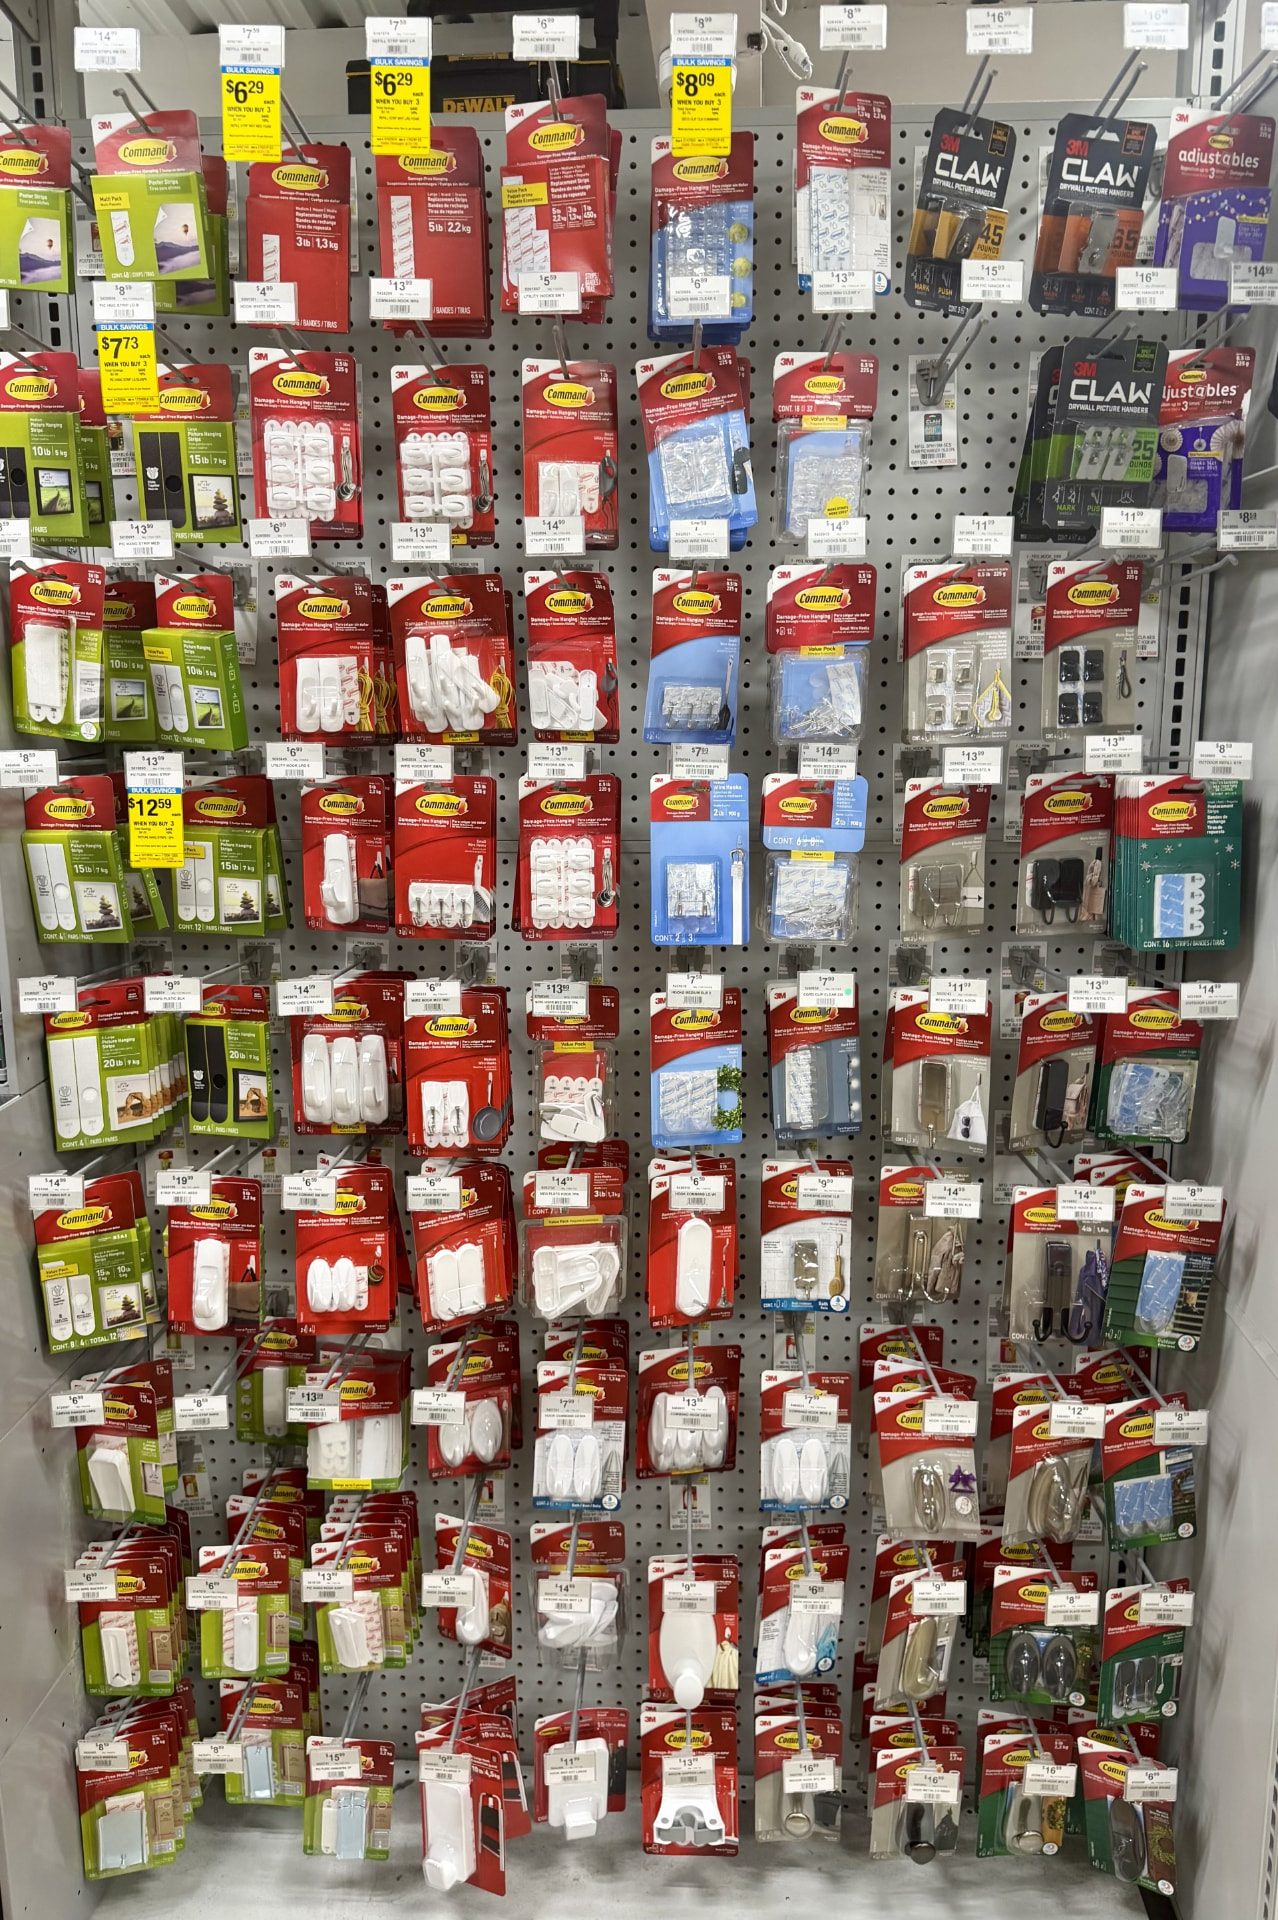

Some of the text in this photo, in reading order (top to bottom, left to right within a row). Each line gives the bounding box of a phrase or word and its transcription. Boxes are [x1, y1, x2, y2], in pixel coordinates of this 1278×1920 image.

[801, 93, 813, 101] 3M
[511, 110, 524, 118] 3M
[1176, 114, 1188, 122] 3M
[98, 122, 112, 130] 3M
[823, 123, 860, 137] Command
[123, 145, 167, 157] Command
[403, 156, 446, 167] Command
[1179, 148, 1259, 168] adjustables
[677, 164, 720, 176] Command
[935, 152, 1001, 188] CLAW
[1061, 157, 1139, 187] CLAW
[932, 177, 997, 199] DRYWALL PICTURE HANGERS
[1059, 182, 1134, 198] DRYWALL PICTURE HANGERS
[981, 224, 1003, 247] 45
[977, 244, 999, 253] POUNDS
[254, 352, 268, 361] 3M
[9, 382, 49, 393] Command
[665, 380, 707, 394] Command
[807, 380, 840, 391] Command
[1069, 378, 1150, 404] CLAW
[418, 394, 458, 404] Command
[1068, 403, 1149, 414] DRYWALL PICTURE HANGERS
[777, 571, 790, 579] 3M
[1052, 566, 1065, 575] 3M
[159, 578, 169, 586] 3M
[34, 586, 74, 600] Command
[938, 589, 978, 601] Command
[678, 598, 714, 607] Command
[302, 603, 342, 614] Command
[523, 780, 537, 788] 3M
[48, 802, 87, 814] Command
[323, 799, 356, 810] Command
[545, 800, 585, 811] Command
[1048, 797, 1086, 810] Command
[900, 994, 913, 1002] 3M
[53, 1015, 87, 1025] Command
[1133, 1012, 1175, 1024] Command
[429, 1022, 470, 1033] Command
[919, 1017, 960, 1032] Command
[1131, 1189, 1145, 1197] 3M
[61, 1208, 104, 1225] Command
